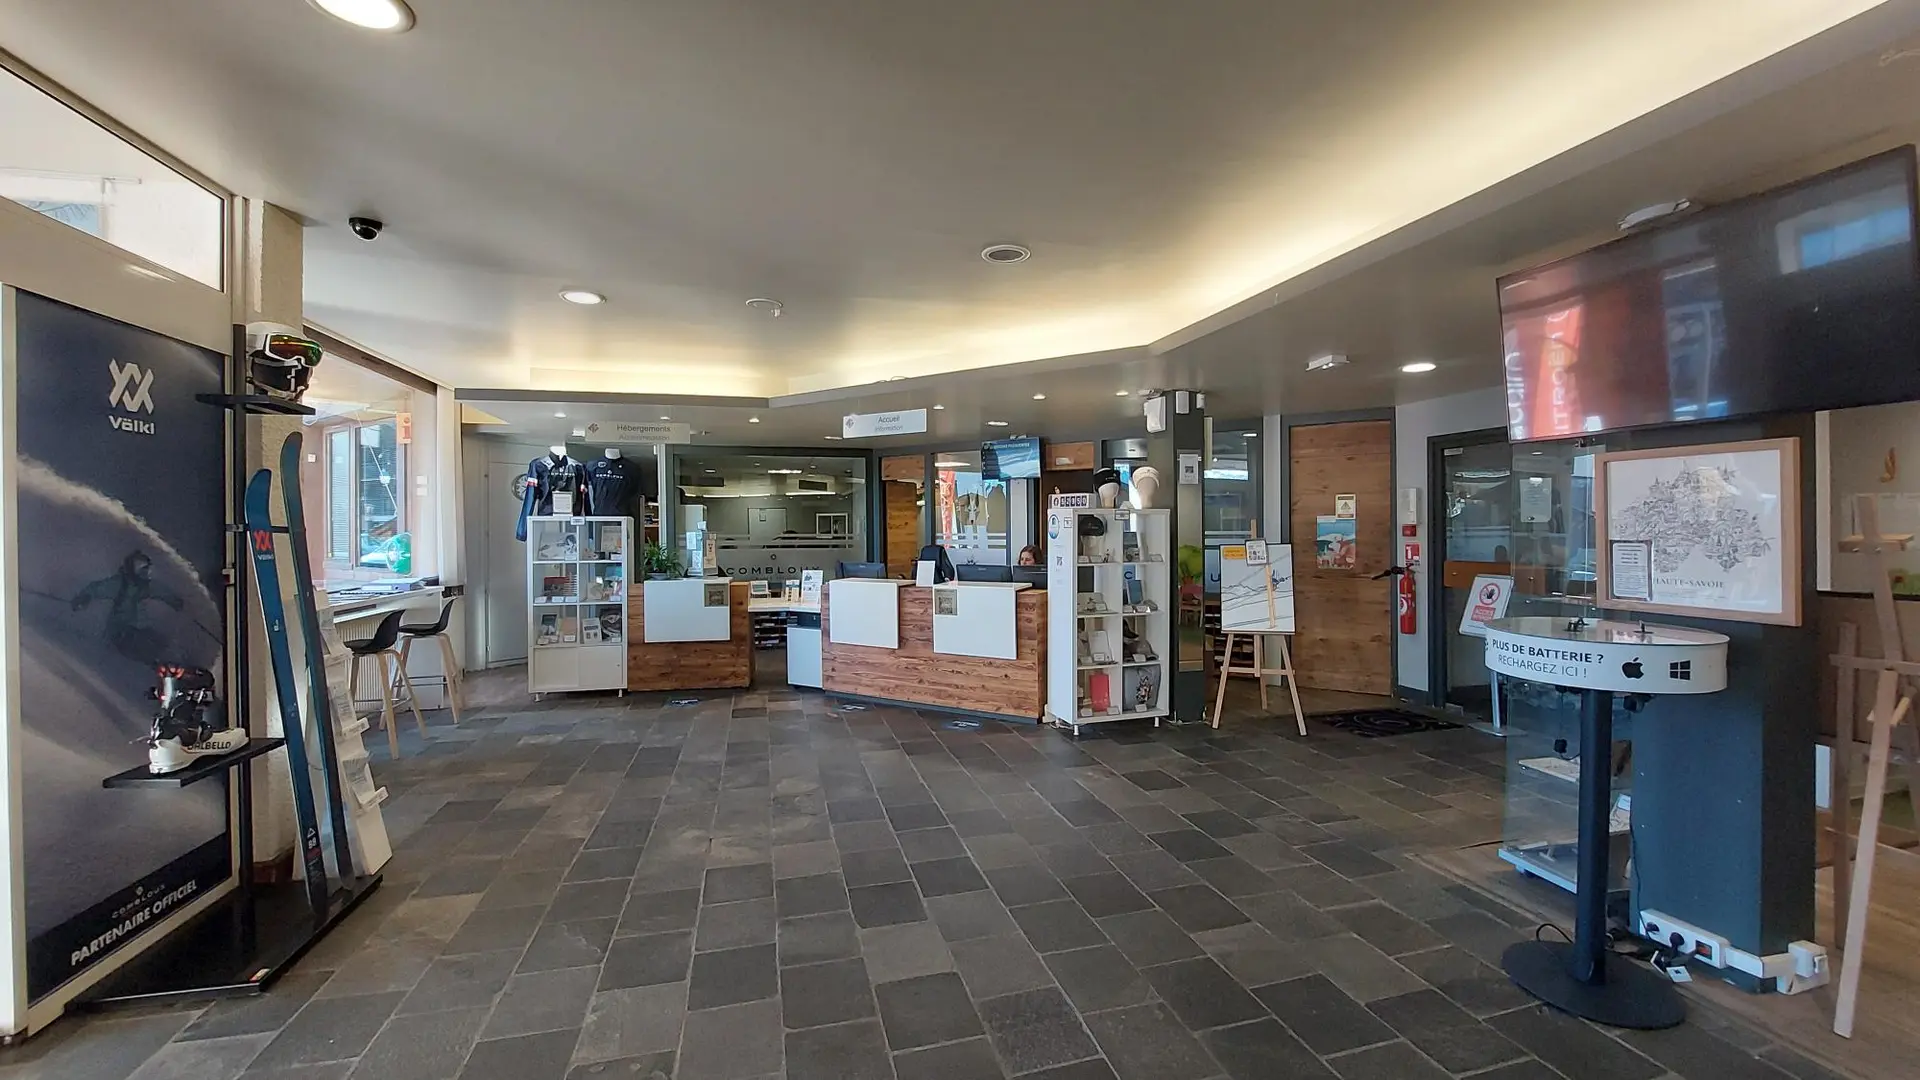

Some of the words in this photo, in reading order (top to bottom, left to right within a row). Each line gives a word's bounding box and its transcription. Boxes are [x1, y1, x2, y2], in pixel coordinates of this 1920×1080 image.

[108, 415, 155, 435] Völkl
[616, 424, 671, 433] Hébergements
[878, 415, 901, 423] Accueil
[1492, 638, 1510, 652] PLUS
[1512, 643, 1525, 655] DE
[1528, 646, 1592, 663] BATTERIE
[1596, 653, 1604, 664] ?
[1498, 654, 1557, 675] RECHARGEZ
[1561, 665, 1578, 677] ICI
[70, 907, 152, 967] PARTENAIRE
[152, 879, 198, 914] OFFICIEL
